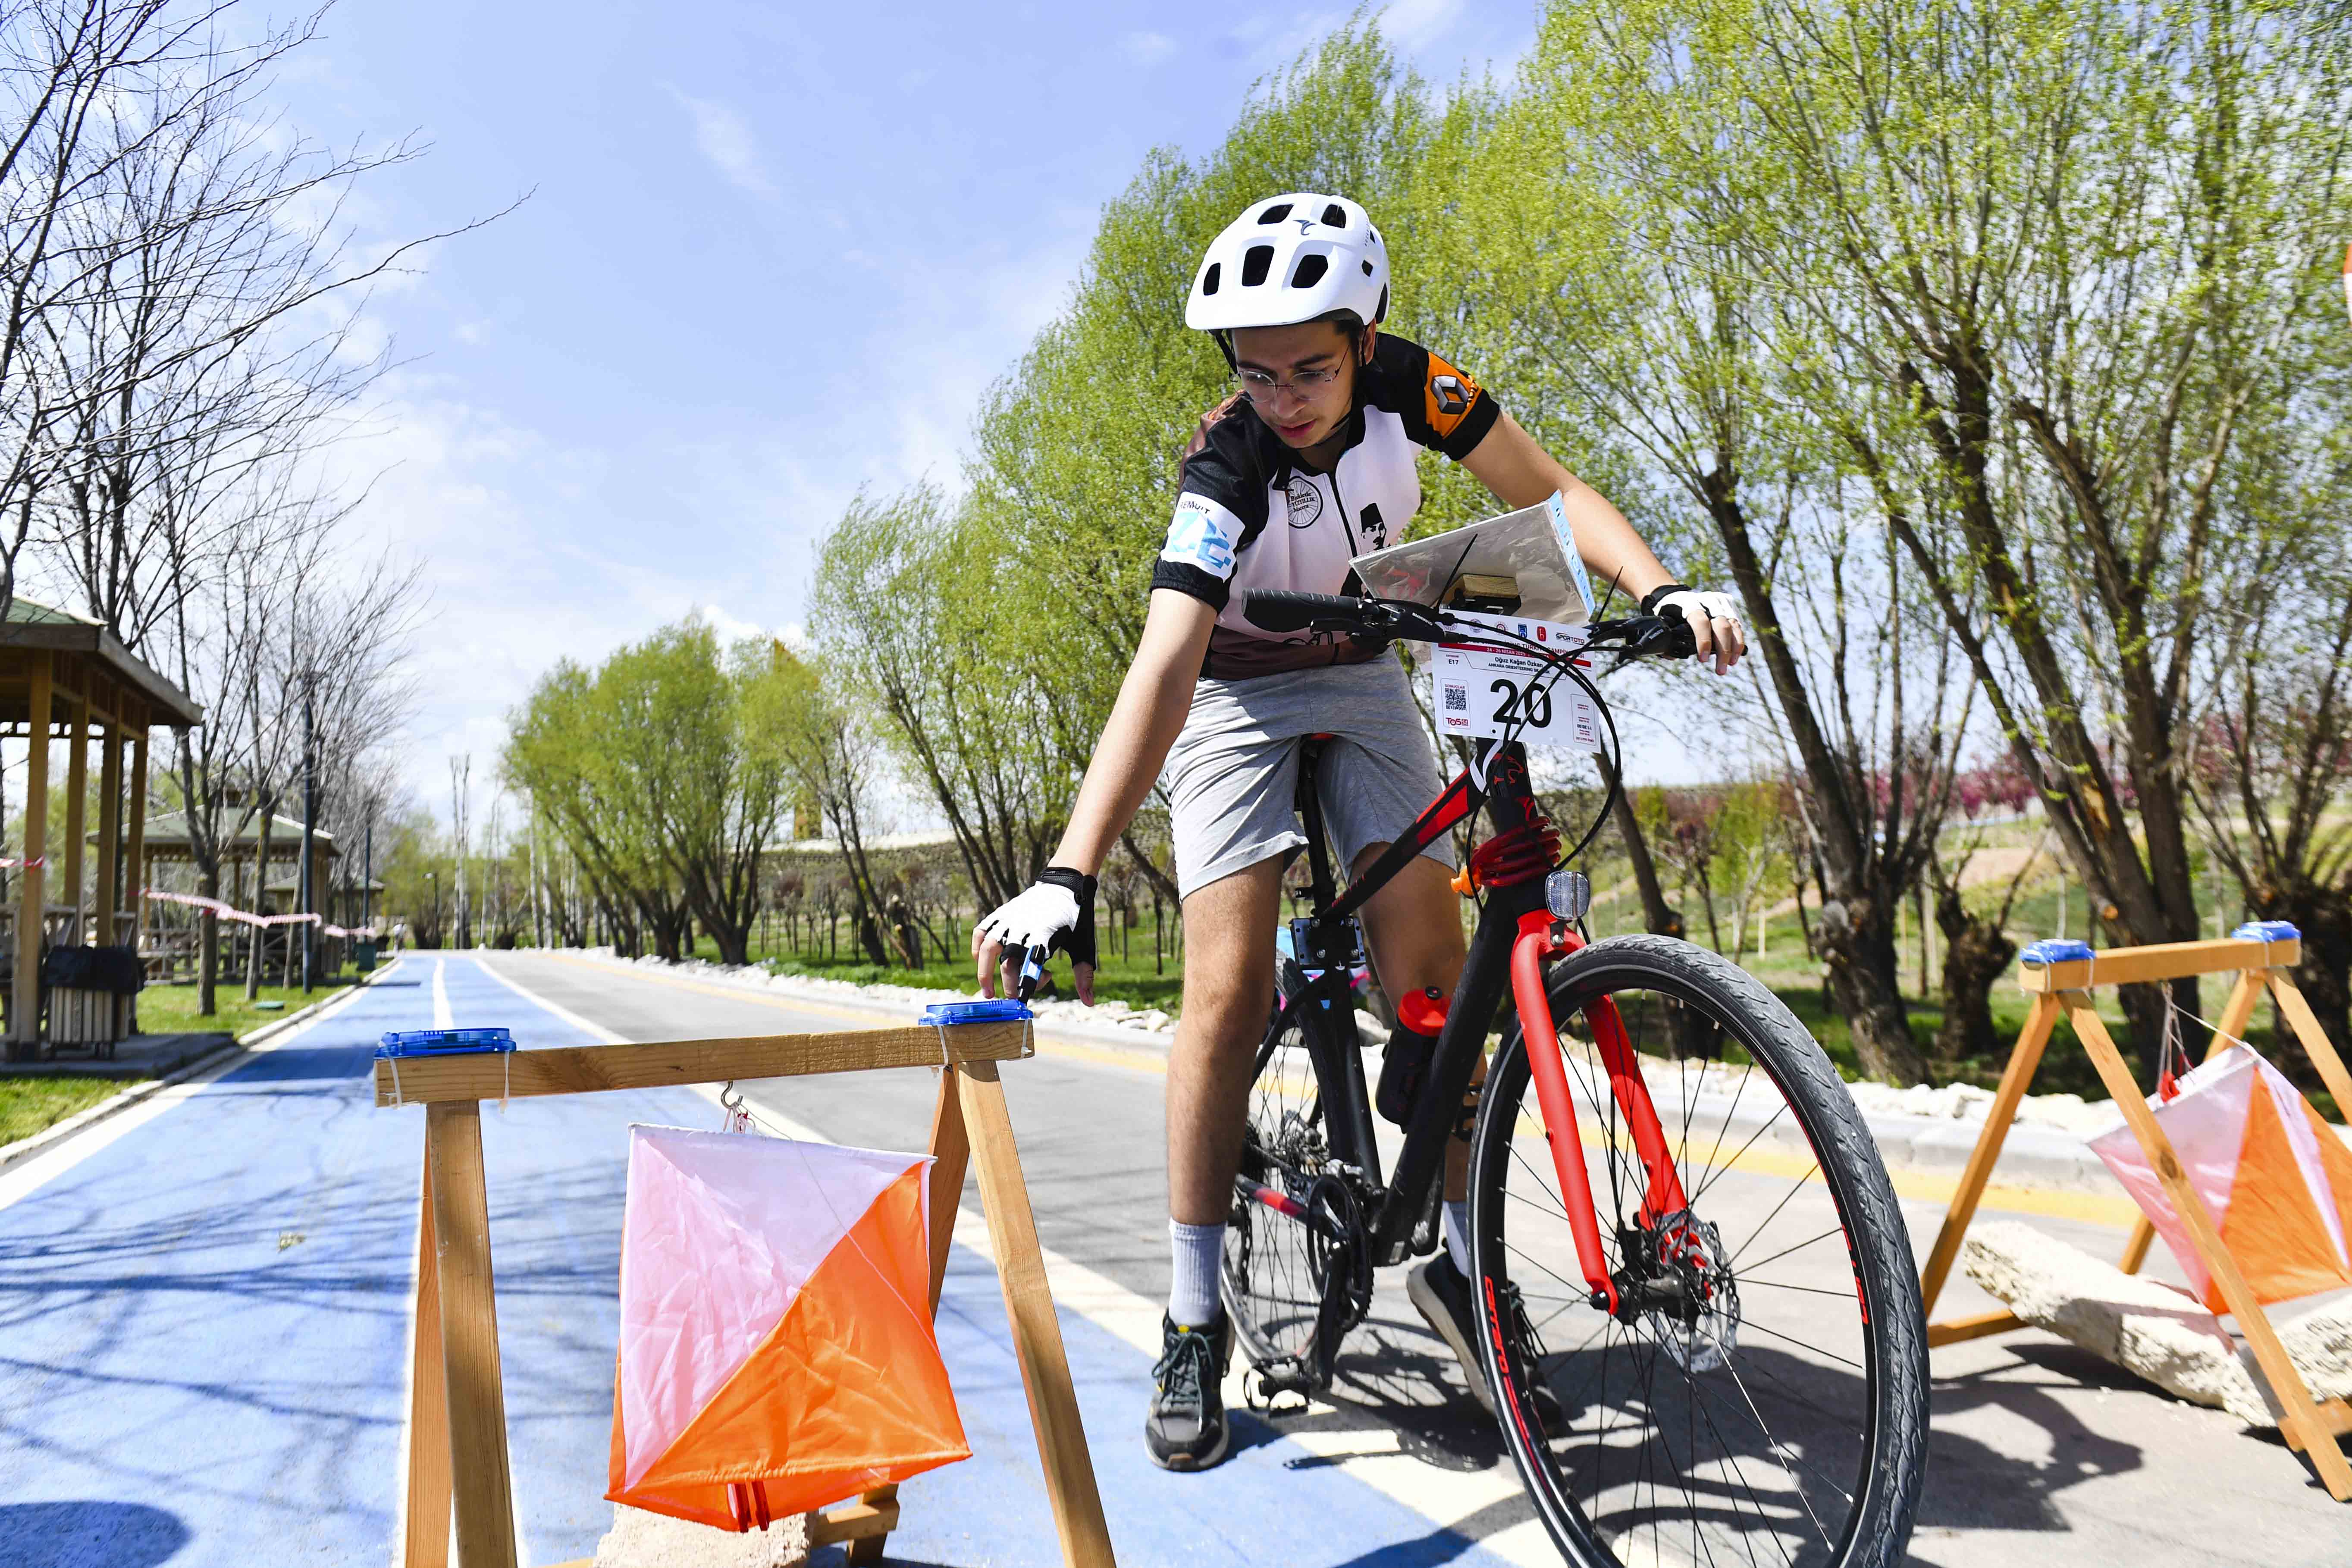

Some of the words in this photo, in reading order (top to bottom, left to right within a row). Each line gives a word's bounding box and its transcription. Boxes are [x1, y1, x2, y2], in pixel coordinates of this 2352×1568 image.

[1510, 658, 1526, 666] Kağan
[1527, 659, 1543, 667] Özkan
[1490, 679, 1552, 728] 20
